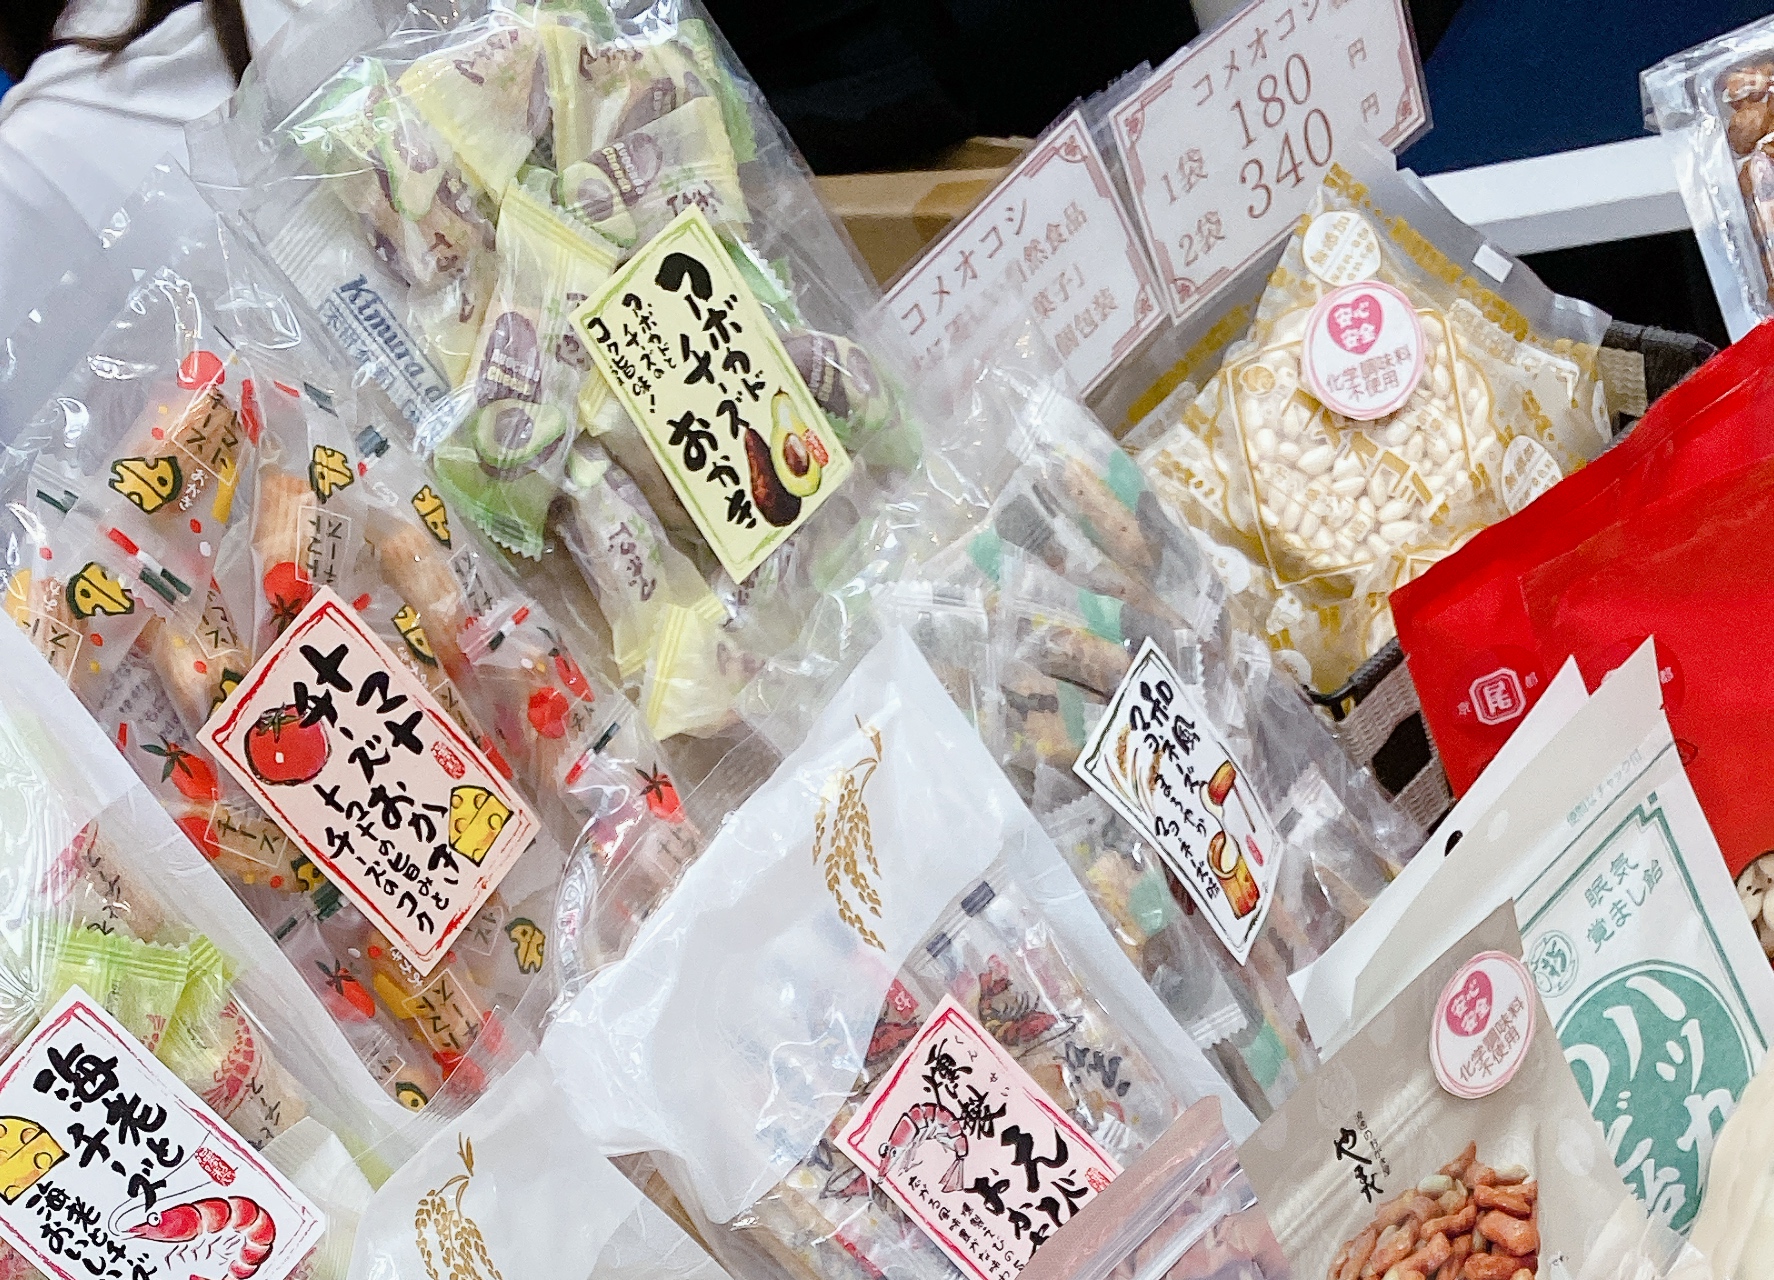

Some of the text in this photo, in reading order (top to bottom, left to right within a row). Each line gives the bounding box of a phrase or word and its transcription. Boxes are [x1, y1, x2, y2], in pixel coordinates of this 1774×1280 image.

[1160, 39, 1367, 206] 1袋 180 円
[1178, 91, 1380, 267] 2袋 340 円
[901, 199, 1028, 335] コメオコシ
[655, 252, 767, 403] アボカド
[680, 334, 752, 439] チーズ
[667, 410, 756, 529] おかき
[300, 644, 424, 756] トマト
[326, 826, 434, 935] チーズのコク
[1584, 852, 1640, 909] 眠気
[1586, 858, 1664, 954] 覚まし飴
[923, 1038, 1007, 1140] 燻製
[1459, 996, 1524, 1082] 化学調味料
[1479, 1027, 1522, 1079] 不使用
[33, 1042, 185, 1168] 海老と
[67, 1123, 168, 1213] チーズ
[1001, 1123, 1089, 1228] えび
